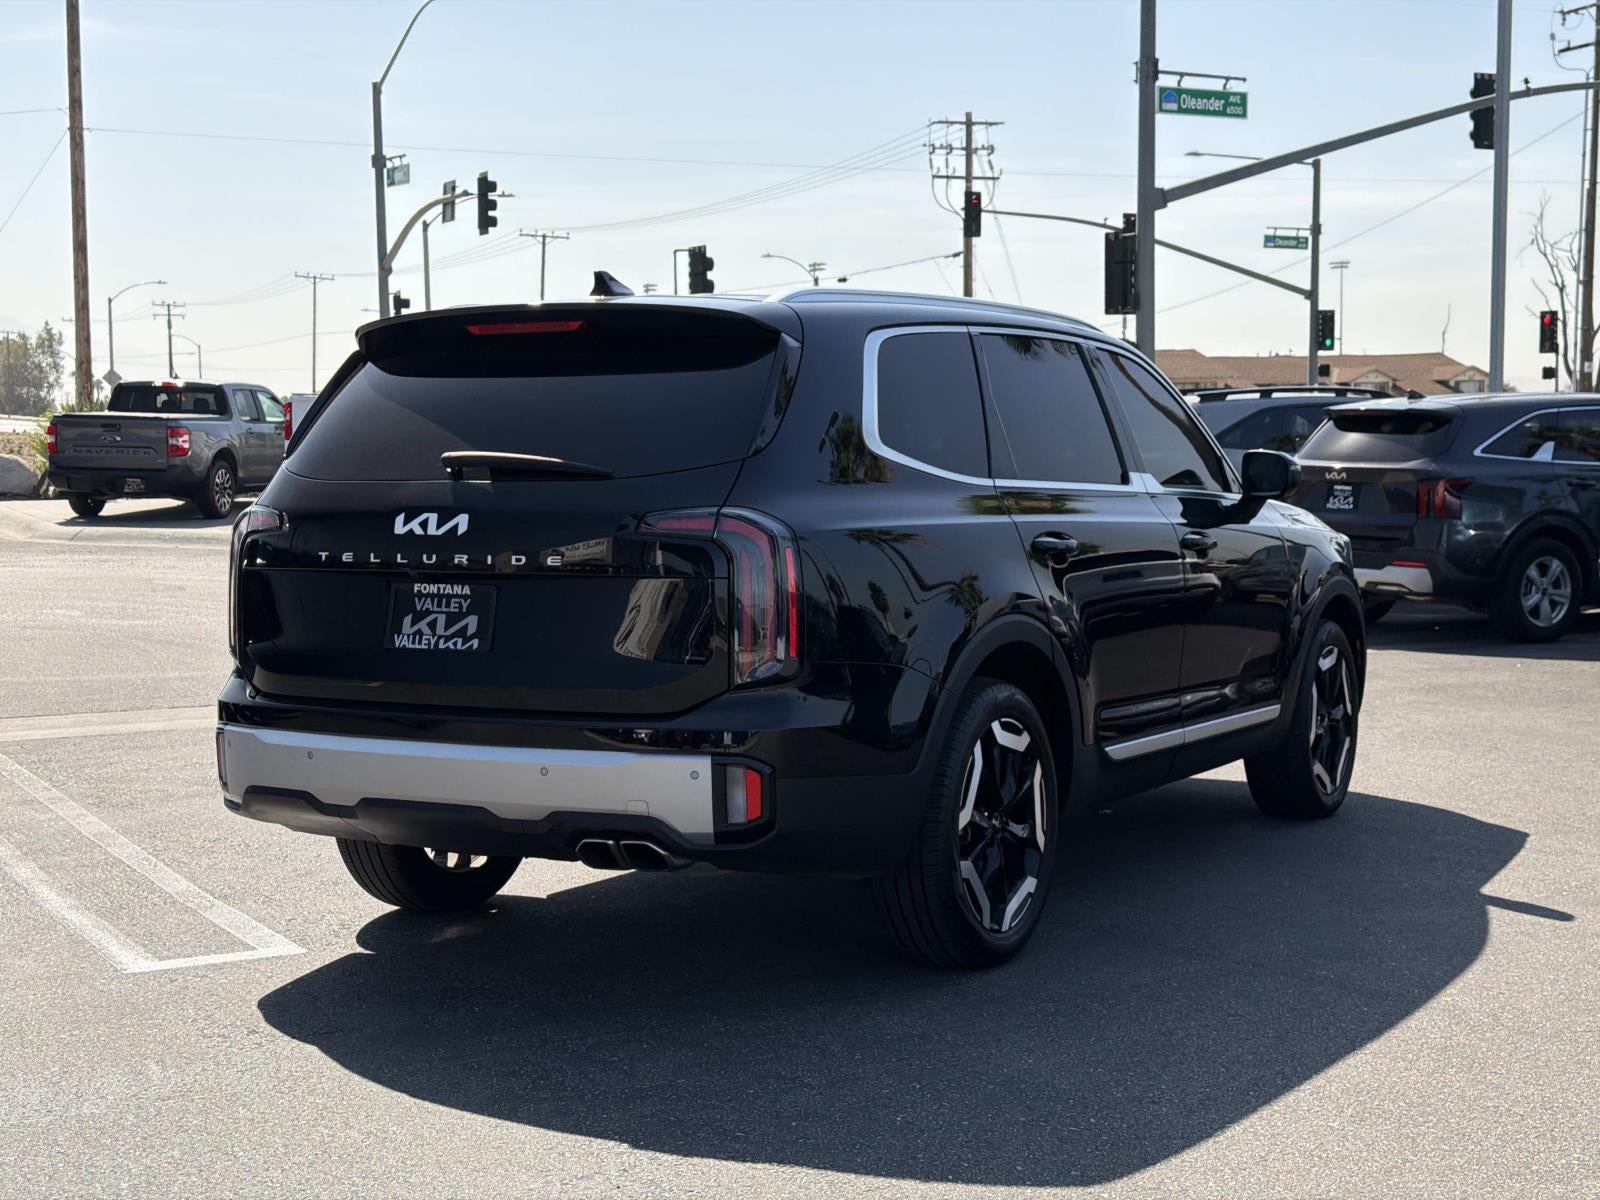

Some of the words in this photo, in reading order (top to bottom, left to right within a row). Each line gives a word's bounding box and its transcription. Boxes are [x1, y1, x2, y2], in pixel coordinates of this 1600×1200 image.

[1180, 94, 1225, 111] Oleander
[1229, 95, 1242, 103] AVE
[393, 512, 469, 536] KIA
[318, 551, 563, 566] TELLURIDE
[413, 583, 471, 595] FONTANA
[414, 597, 471, 612] VALLEY
[401, 613, 479, 636] KIA
[394, 634, 437, 649] VALLEY
[438, 637, 479, 650] KIA
